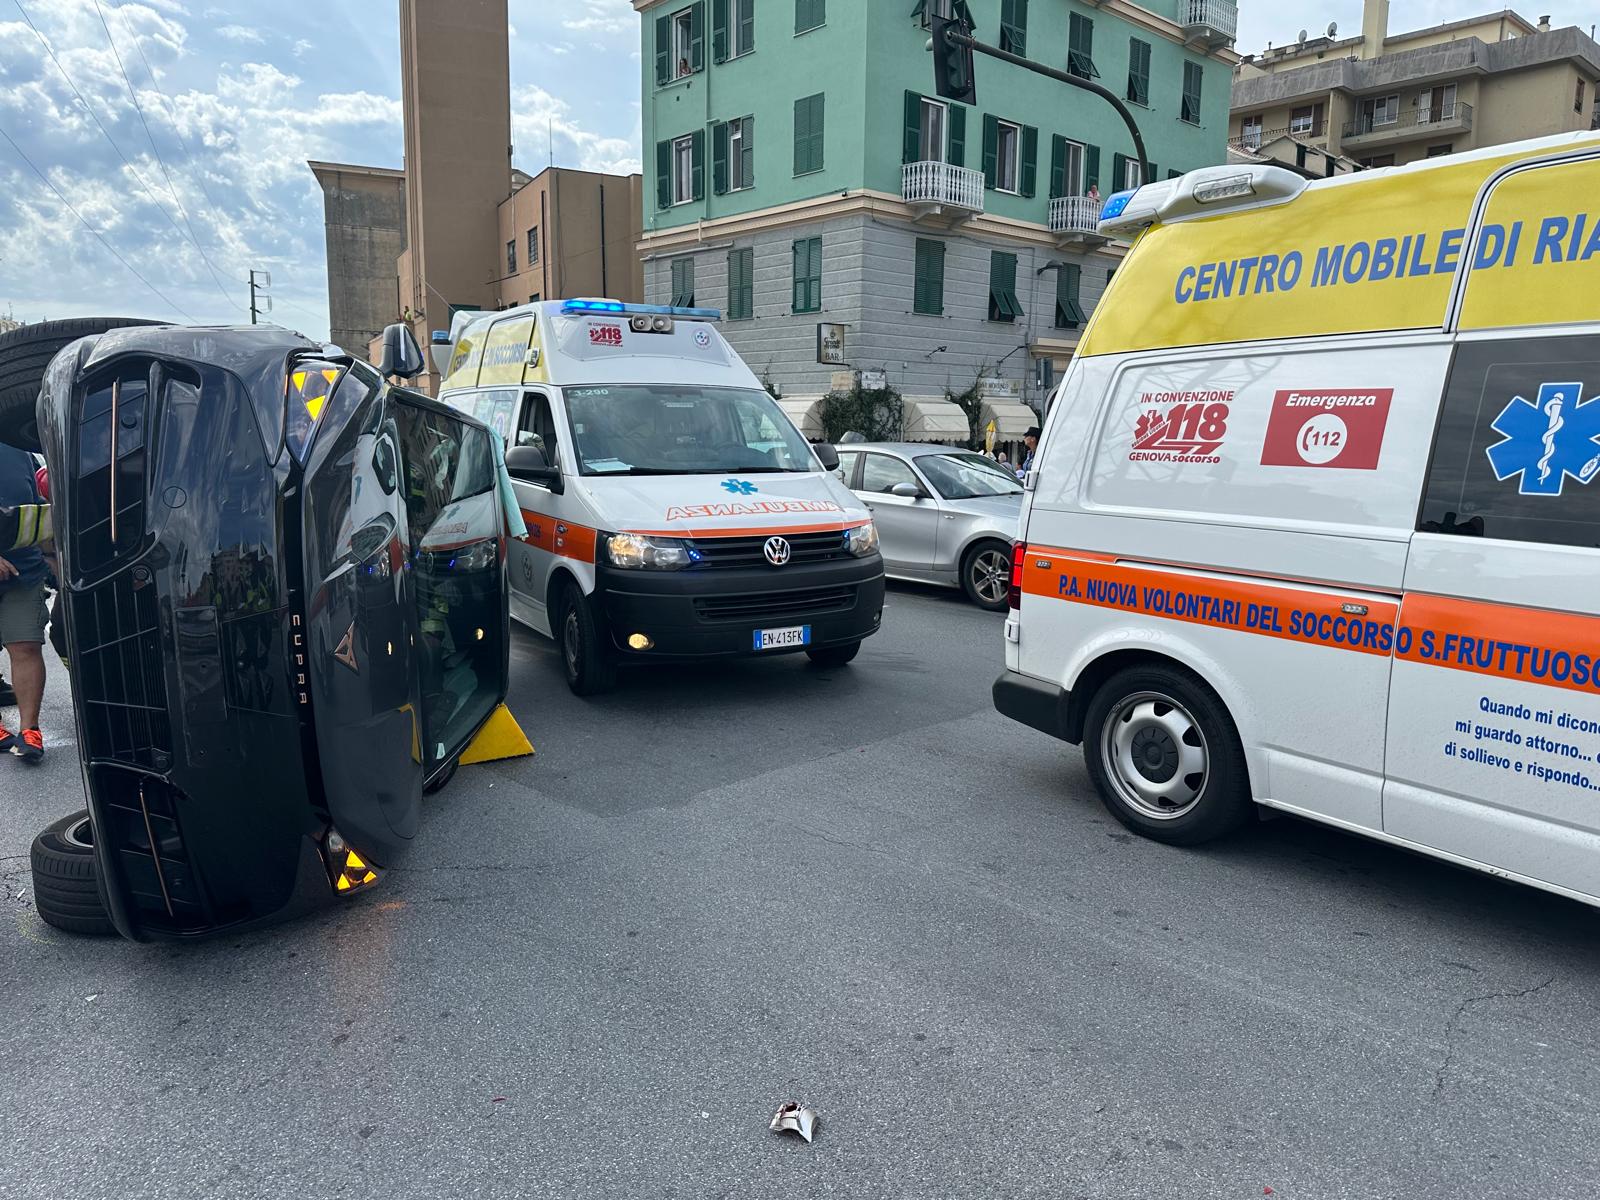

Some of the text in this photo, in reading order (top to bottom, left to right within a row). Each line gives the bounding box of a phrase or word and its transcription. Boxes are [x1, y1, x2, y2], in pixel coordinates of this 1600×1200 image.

[1174, 251, 1303, 304] CENTRO
[1310, 228, 1466, 288] MOBILE
[1472, 221, 1523, 270] DI
[600, 327, 622, 340] 118
[825, 352, 840, 361] BAR
[1141, 391, 1235, 403] IN CONVENZIONE
[1286, 393, 1376, 410] Emergenza
[1165, 403, 1230, 440] 118
[1312, 431, 1341, 447] 112
[1058, 575, 1082, 598] P.A.
[1087, 578, 1137, 608] NUOVA
[1143, 587, 1241, 625] VOLONTARI
[1246, 603, 1282, 632] DEL
[1289, 610, 1413, 654] SOCCORSO
[293, 614, 307, 704] CUPRA
[1479, 697, 1531, 720] Quando
[1535, 710, 1553, 725] mi
[1455, 720, 1471, 734] mi
[1475, 724, 1522, 745] guardo
[1525, 735, 1592, 762] attorno...
[1444, 741, 1457, 757] di
[1460, 746, 1511, 770] sollievo
[1514, 761, 1523, 772] e
